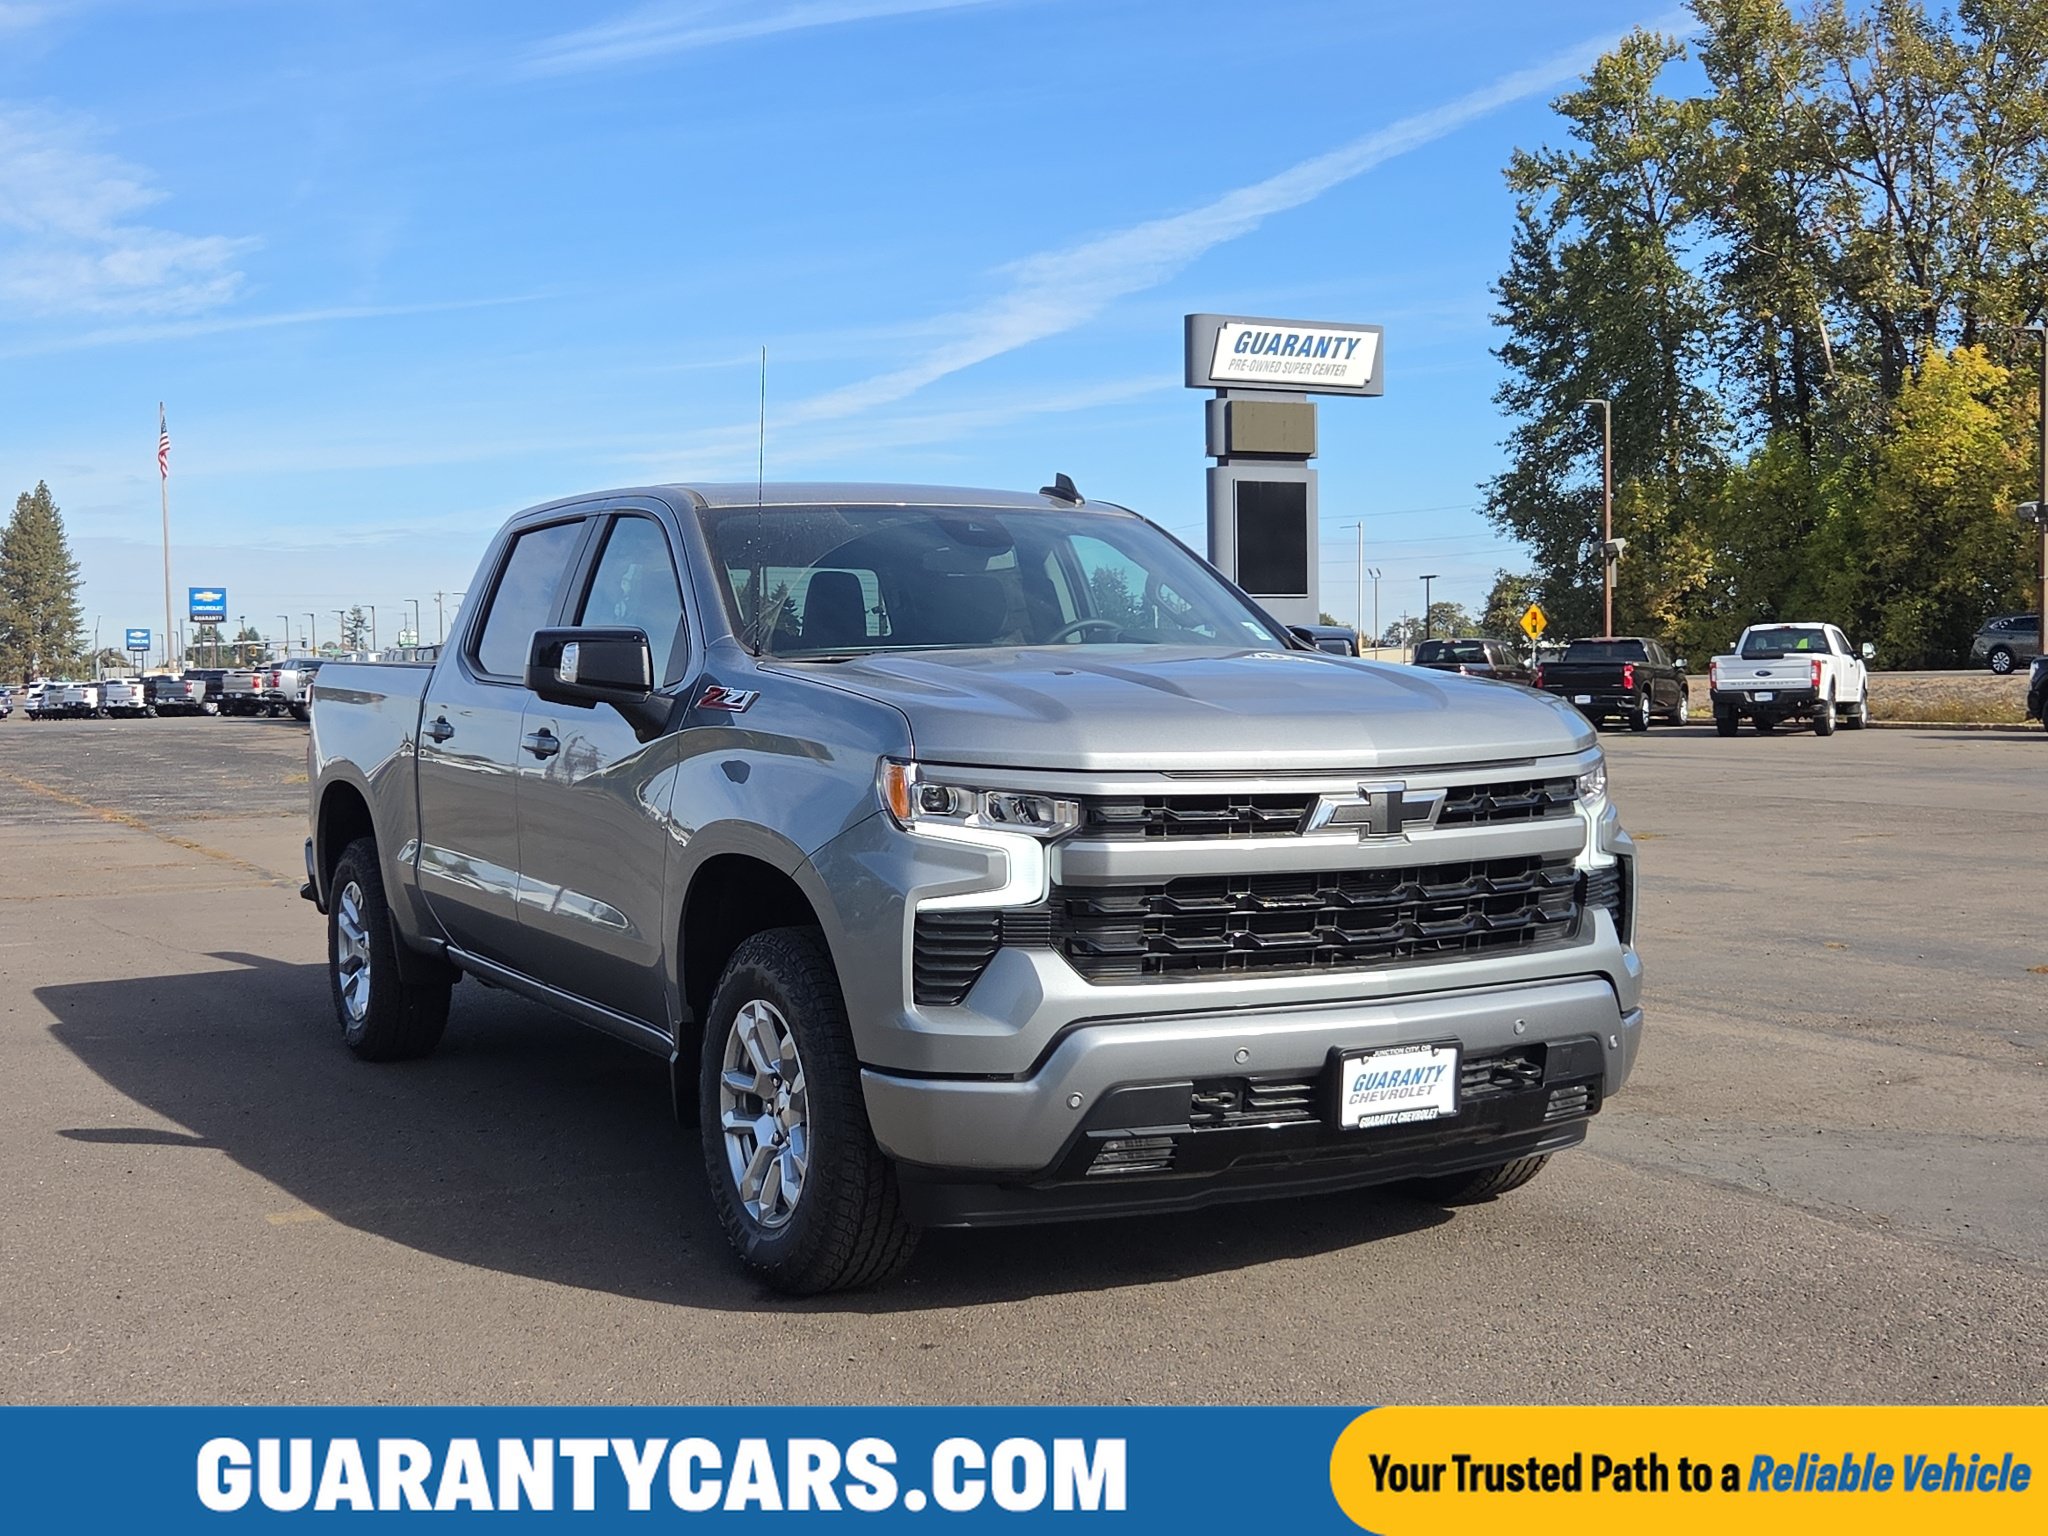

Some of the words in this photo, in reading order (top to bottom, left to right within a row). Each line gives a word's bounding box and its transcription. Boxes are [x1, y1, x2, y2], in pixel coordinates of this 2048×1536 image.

[1234, 331, 1361, 360] GUARANTY
[1229, 358, 1281, 374] PRE-OWNED
[1282, 362, 1312, 375] SUPER
[1313, 363, 1348, 377] CENTER
[1352, 1064, 1447, 1092] GUARANTY
[1349, 1084, 1436, 1105] CHEVROLET
